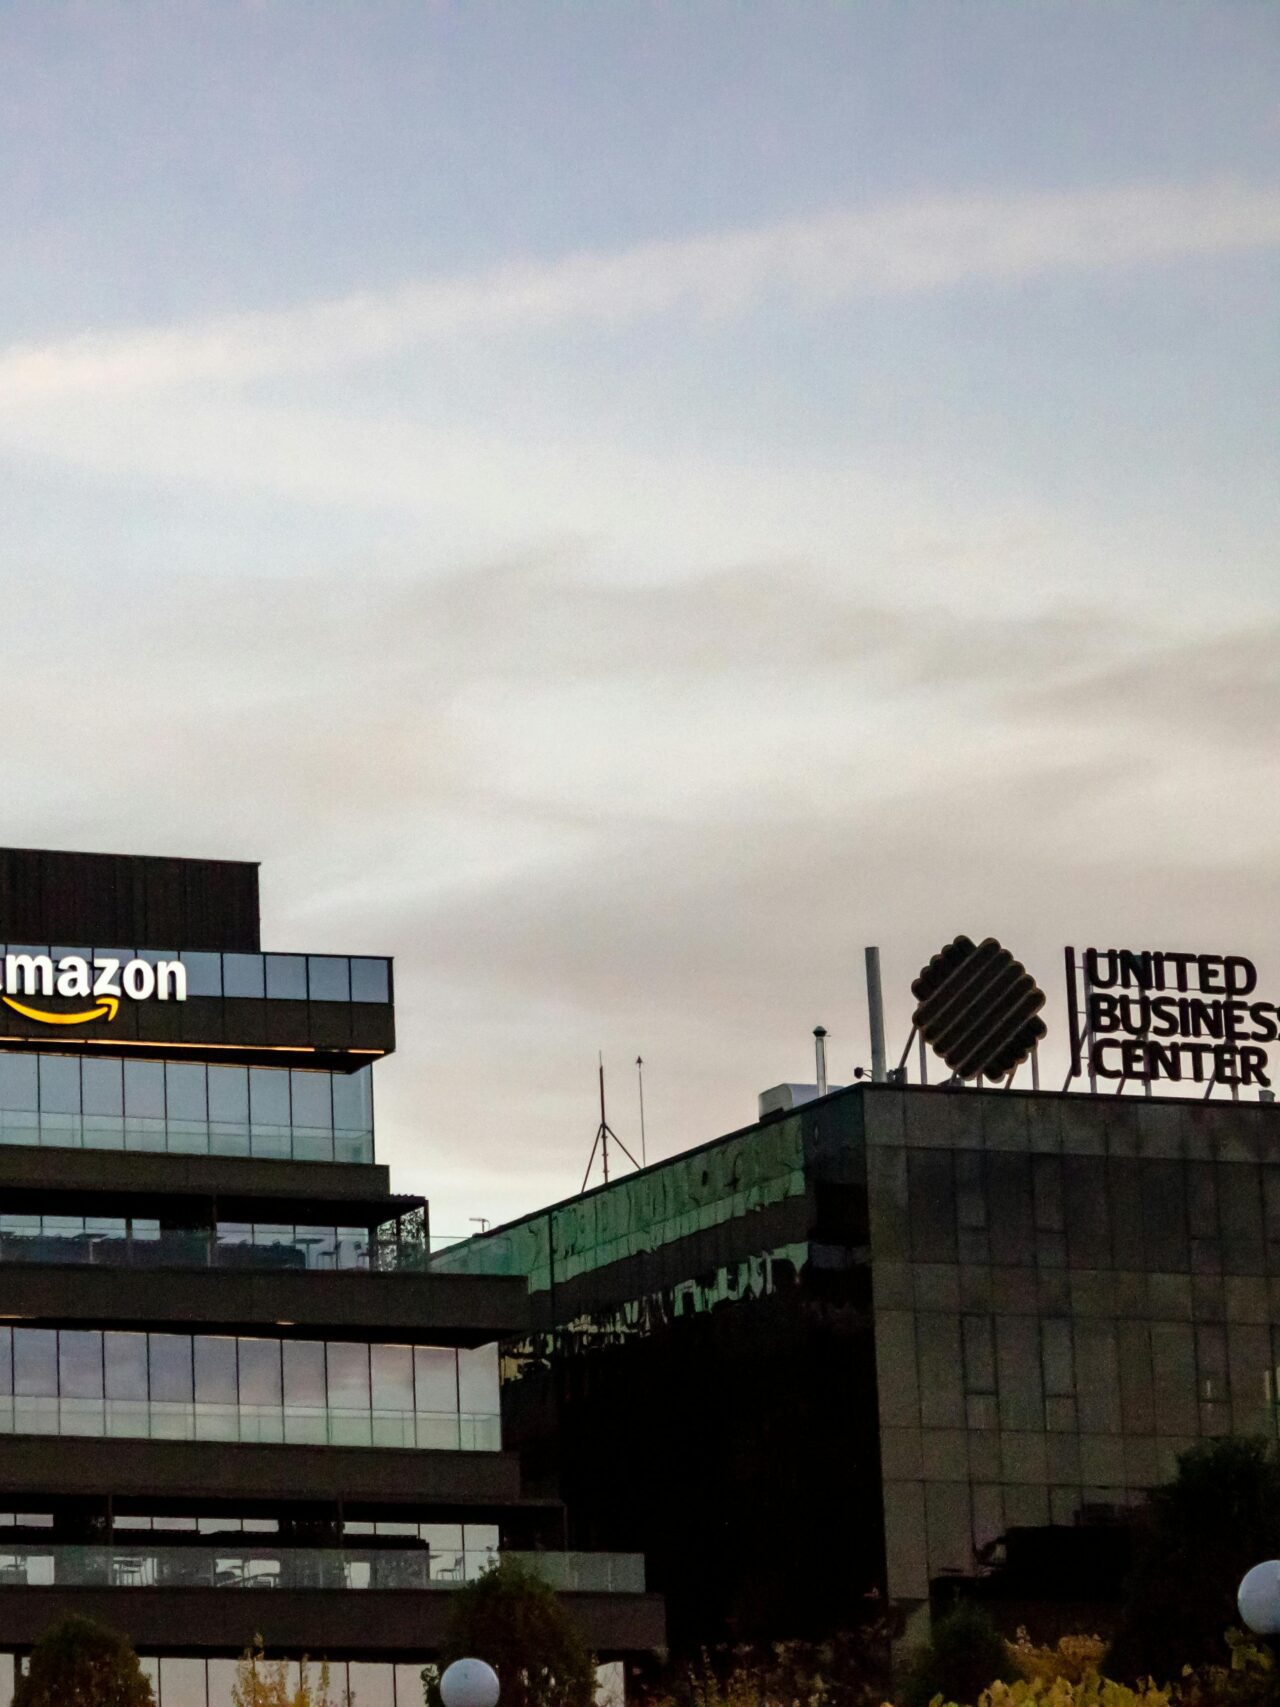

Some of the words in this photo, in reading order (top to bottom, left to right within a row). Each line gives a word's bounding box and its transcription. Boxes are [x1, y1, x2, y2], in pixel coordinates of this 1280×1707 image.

[1086, 947, 1257, 996] UNITED
[1089, 993, 1280, 1043] BUSINES
[1091, 1038, 1271, 1087] CENTER
